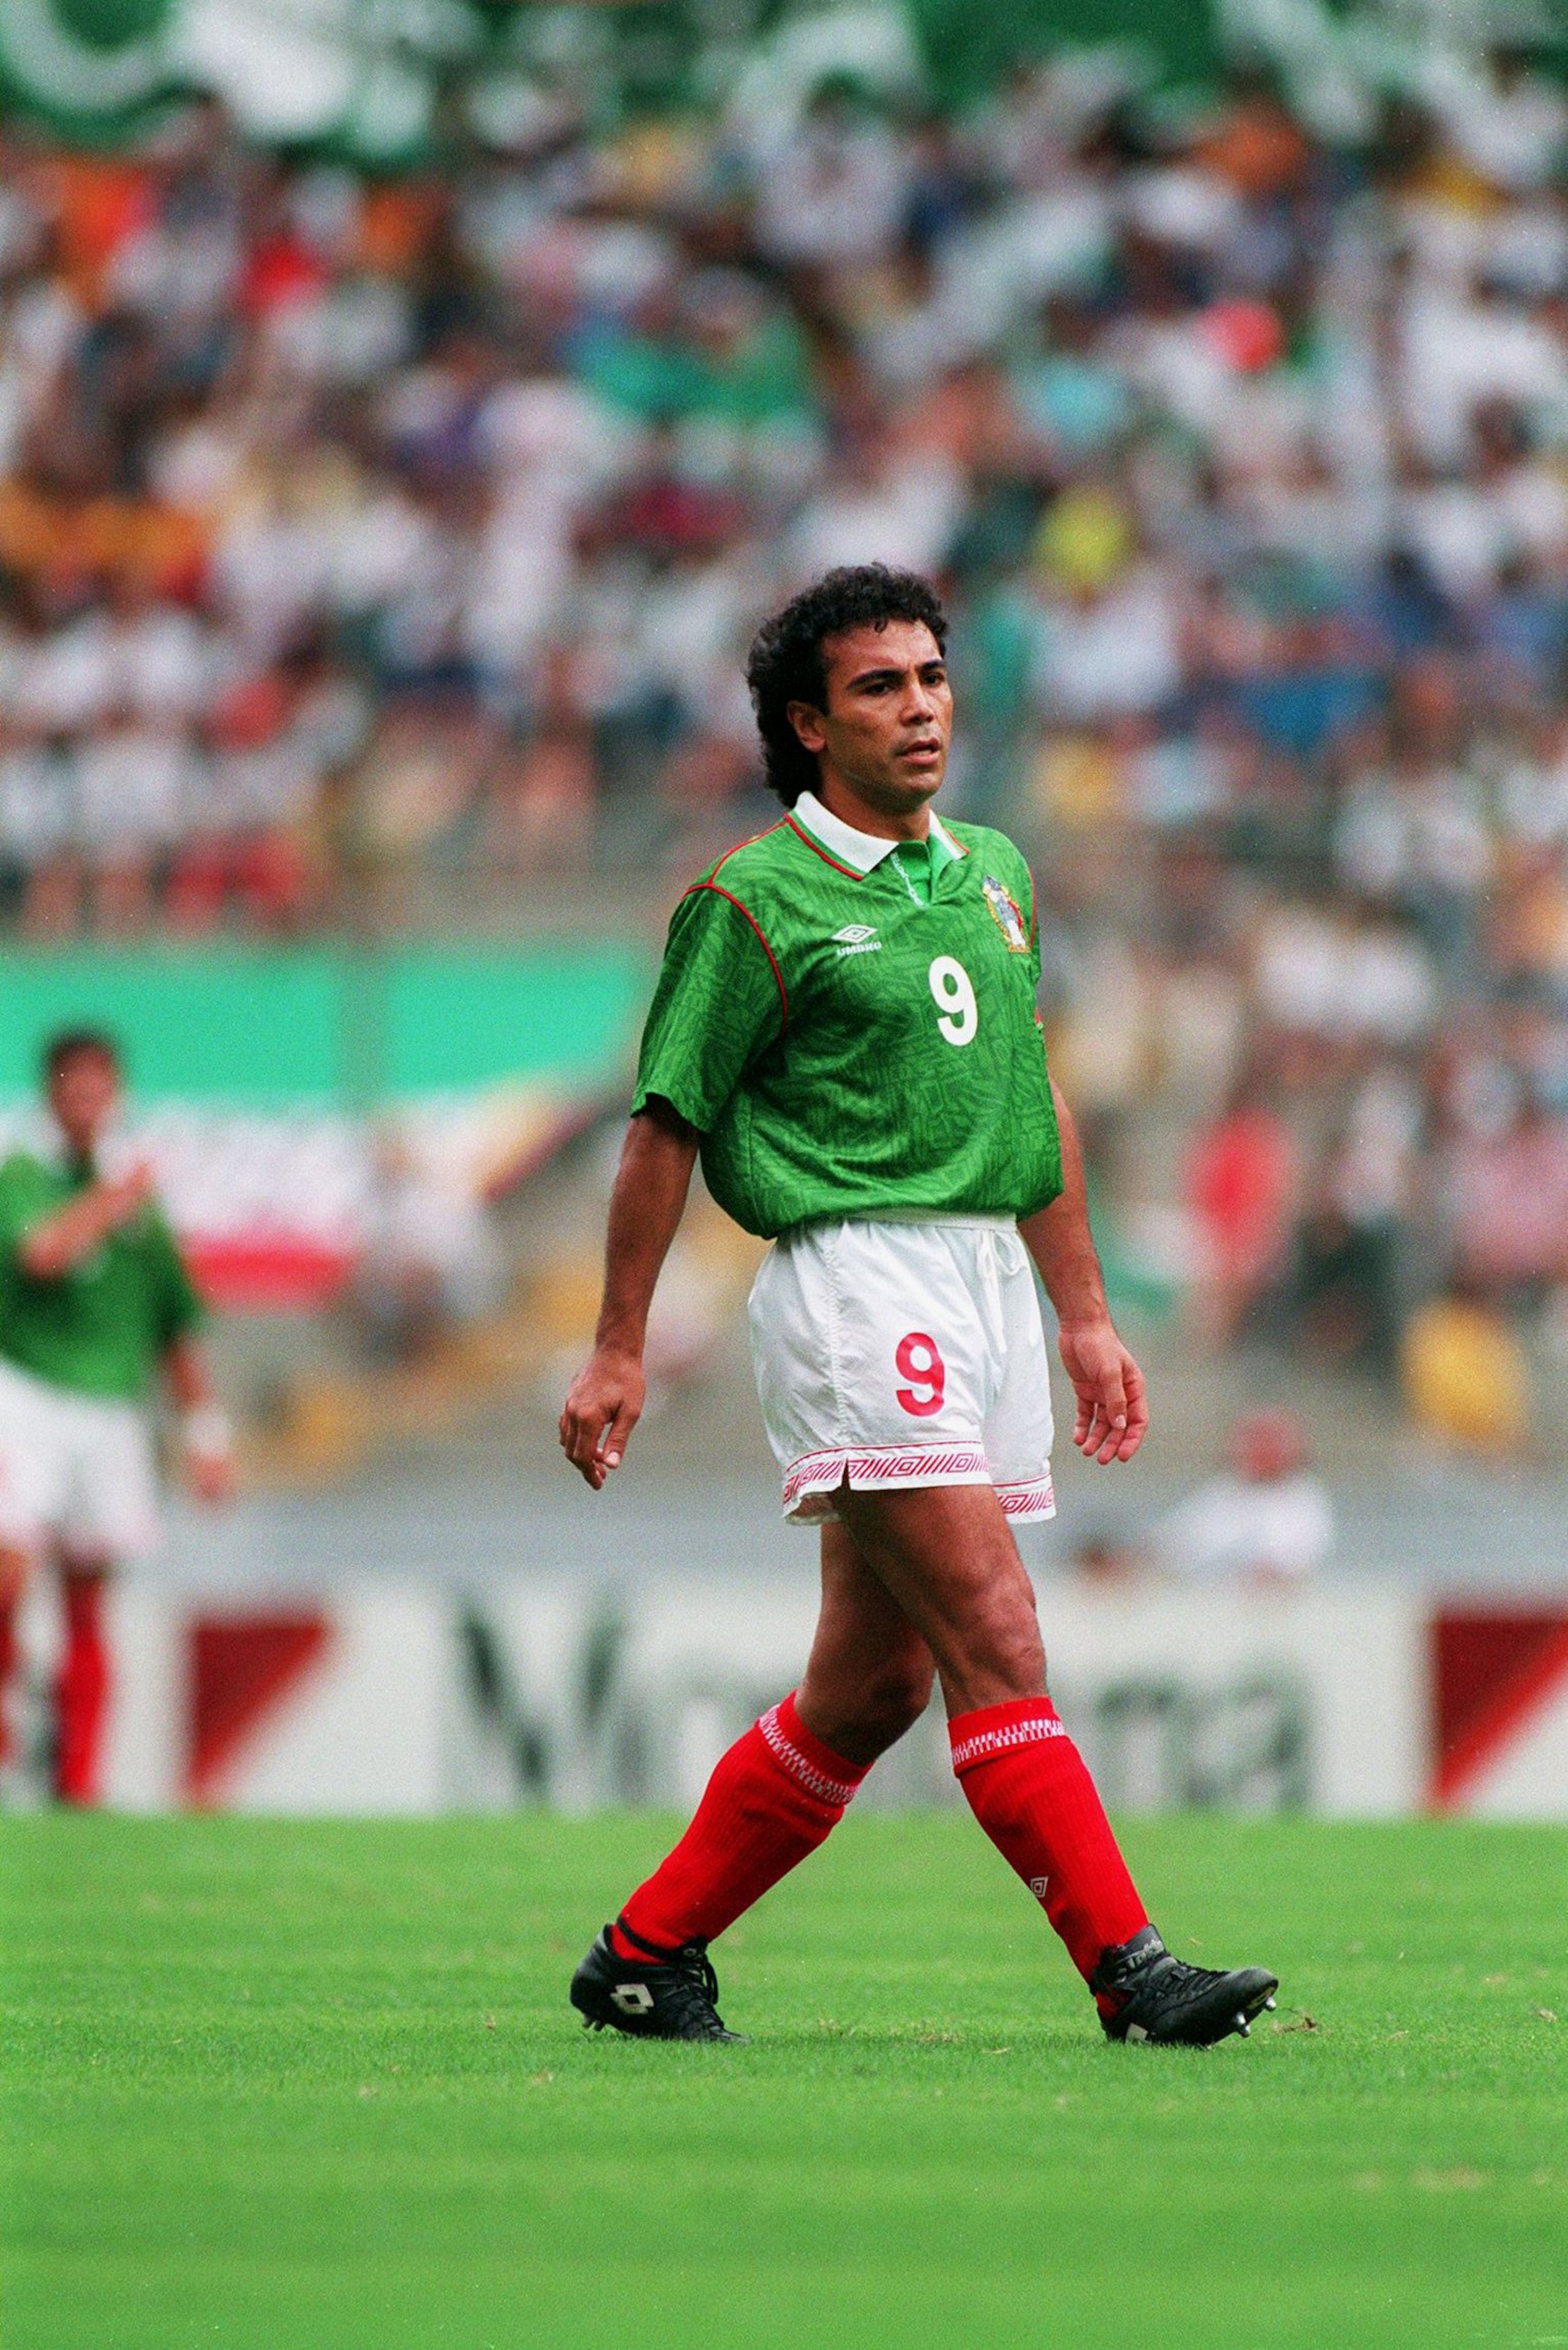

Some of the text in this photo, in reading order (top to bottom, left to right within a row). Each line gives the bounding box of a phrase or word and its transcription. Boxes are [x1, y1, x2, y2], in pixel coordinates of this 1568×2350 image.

[837, 941, 882, 956] UMBRO
[929, 956, 978, 1047] 9
[895, 1332, 945, 1417] 9
